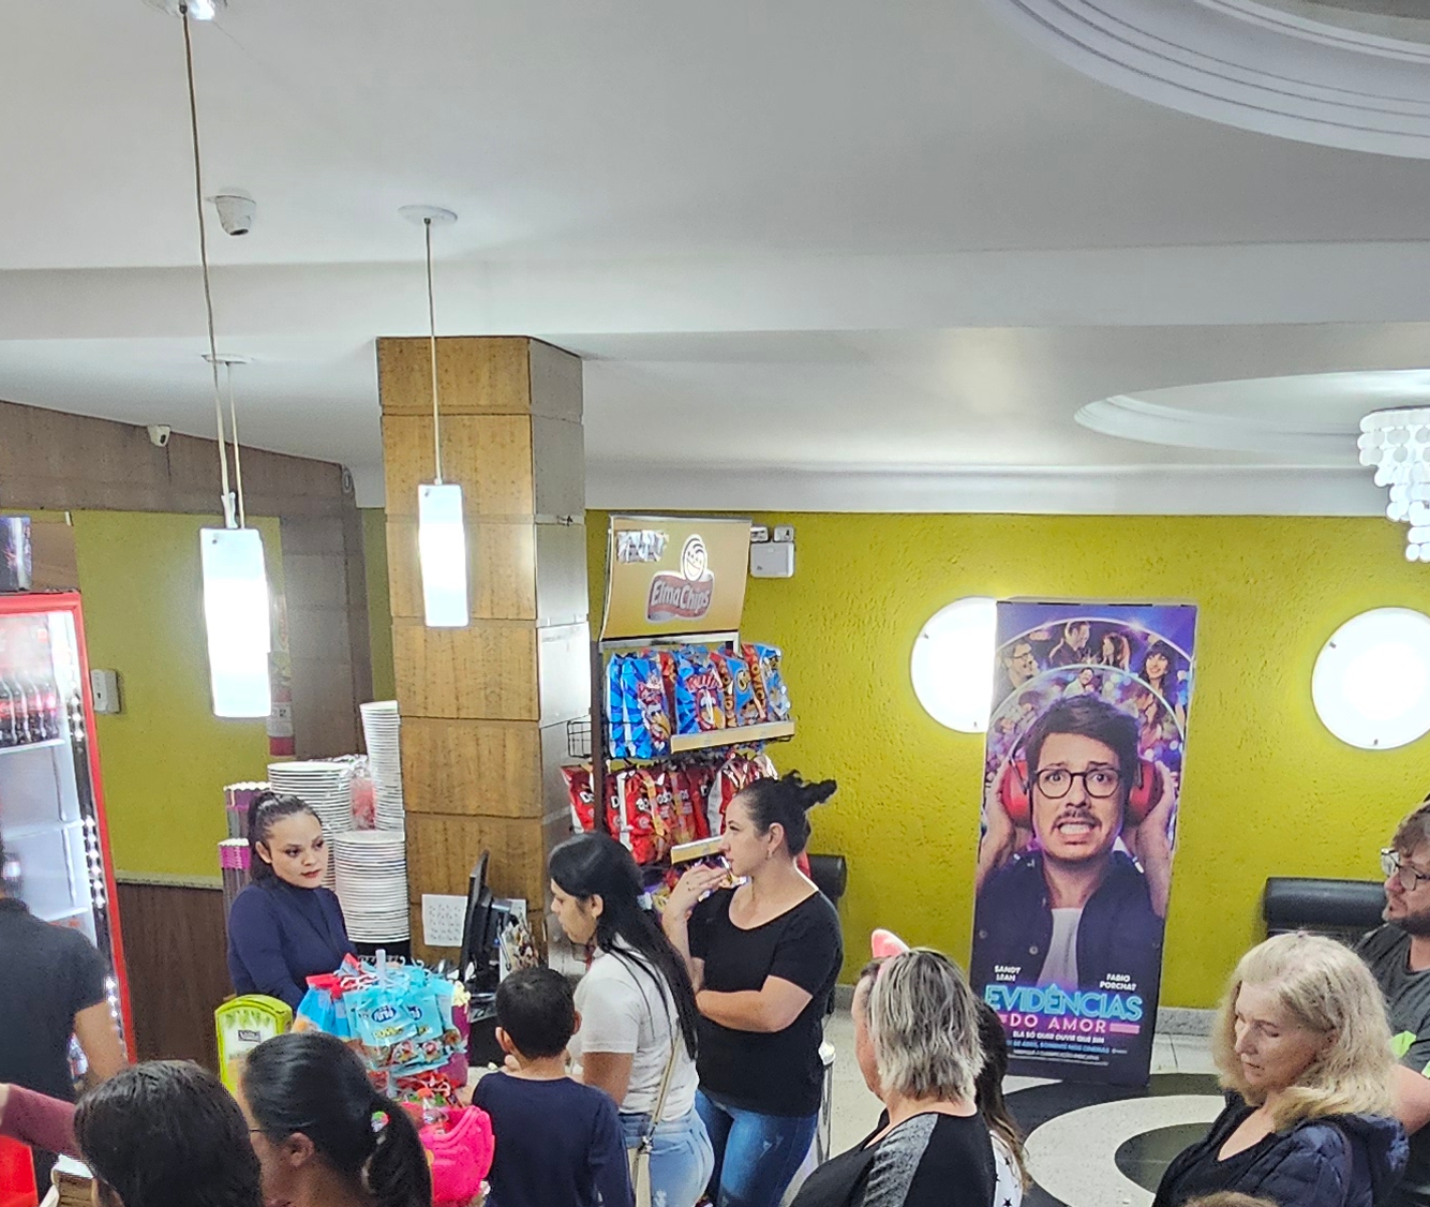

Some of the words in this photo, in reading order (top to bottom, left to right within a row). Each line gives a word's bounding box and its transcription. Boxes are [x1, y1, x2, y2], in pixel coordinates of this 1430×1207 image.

[984, 983, 1144, 1022] EVIDÊNCIAS
[1009, 1013, 1039, 1029] DO
[1048, 1015, 1107, 1034] AMOR
